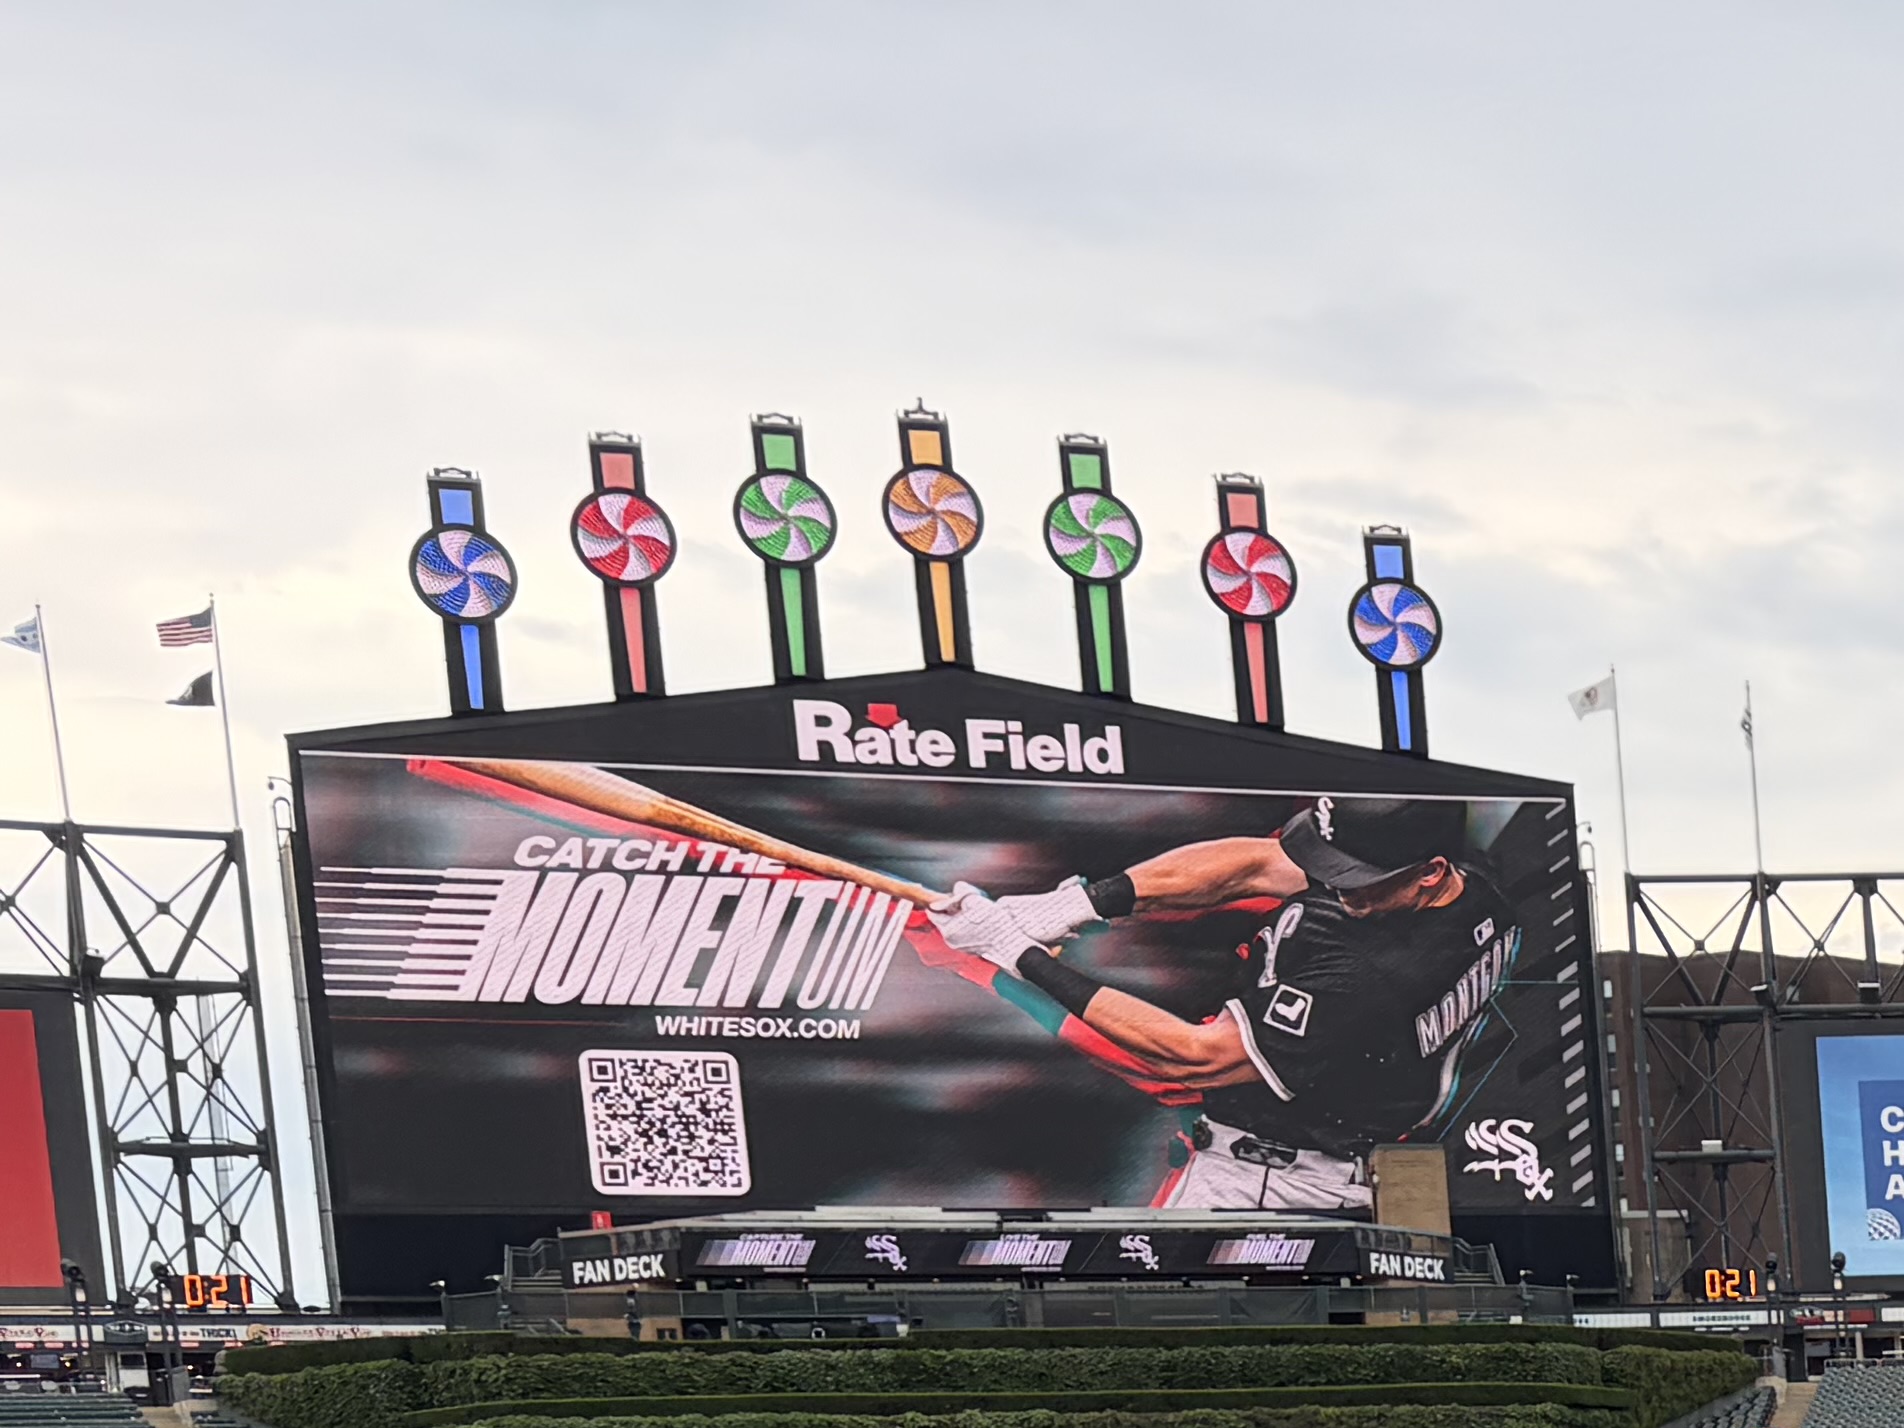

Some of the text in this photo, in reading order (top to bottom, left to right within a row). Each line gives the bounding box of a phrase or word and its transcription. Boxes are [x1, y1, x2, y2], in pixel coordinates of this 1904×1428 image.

[793, 699, 1124, 775] Rate Field
[514, 834, 787, 875] CATCH THE
[656, 1014, 860, 1040] WHITESOX.COM
[573, 1254, 666, 1285] FAN DECK
[1369, 1252, 1445, 1281] FAN DECK
[183, 1274, 250, 1308] 0:21
[1705, 1269, 1756, 1298] 0:21
